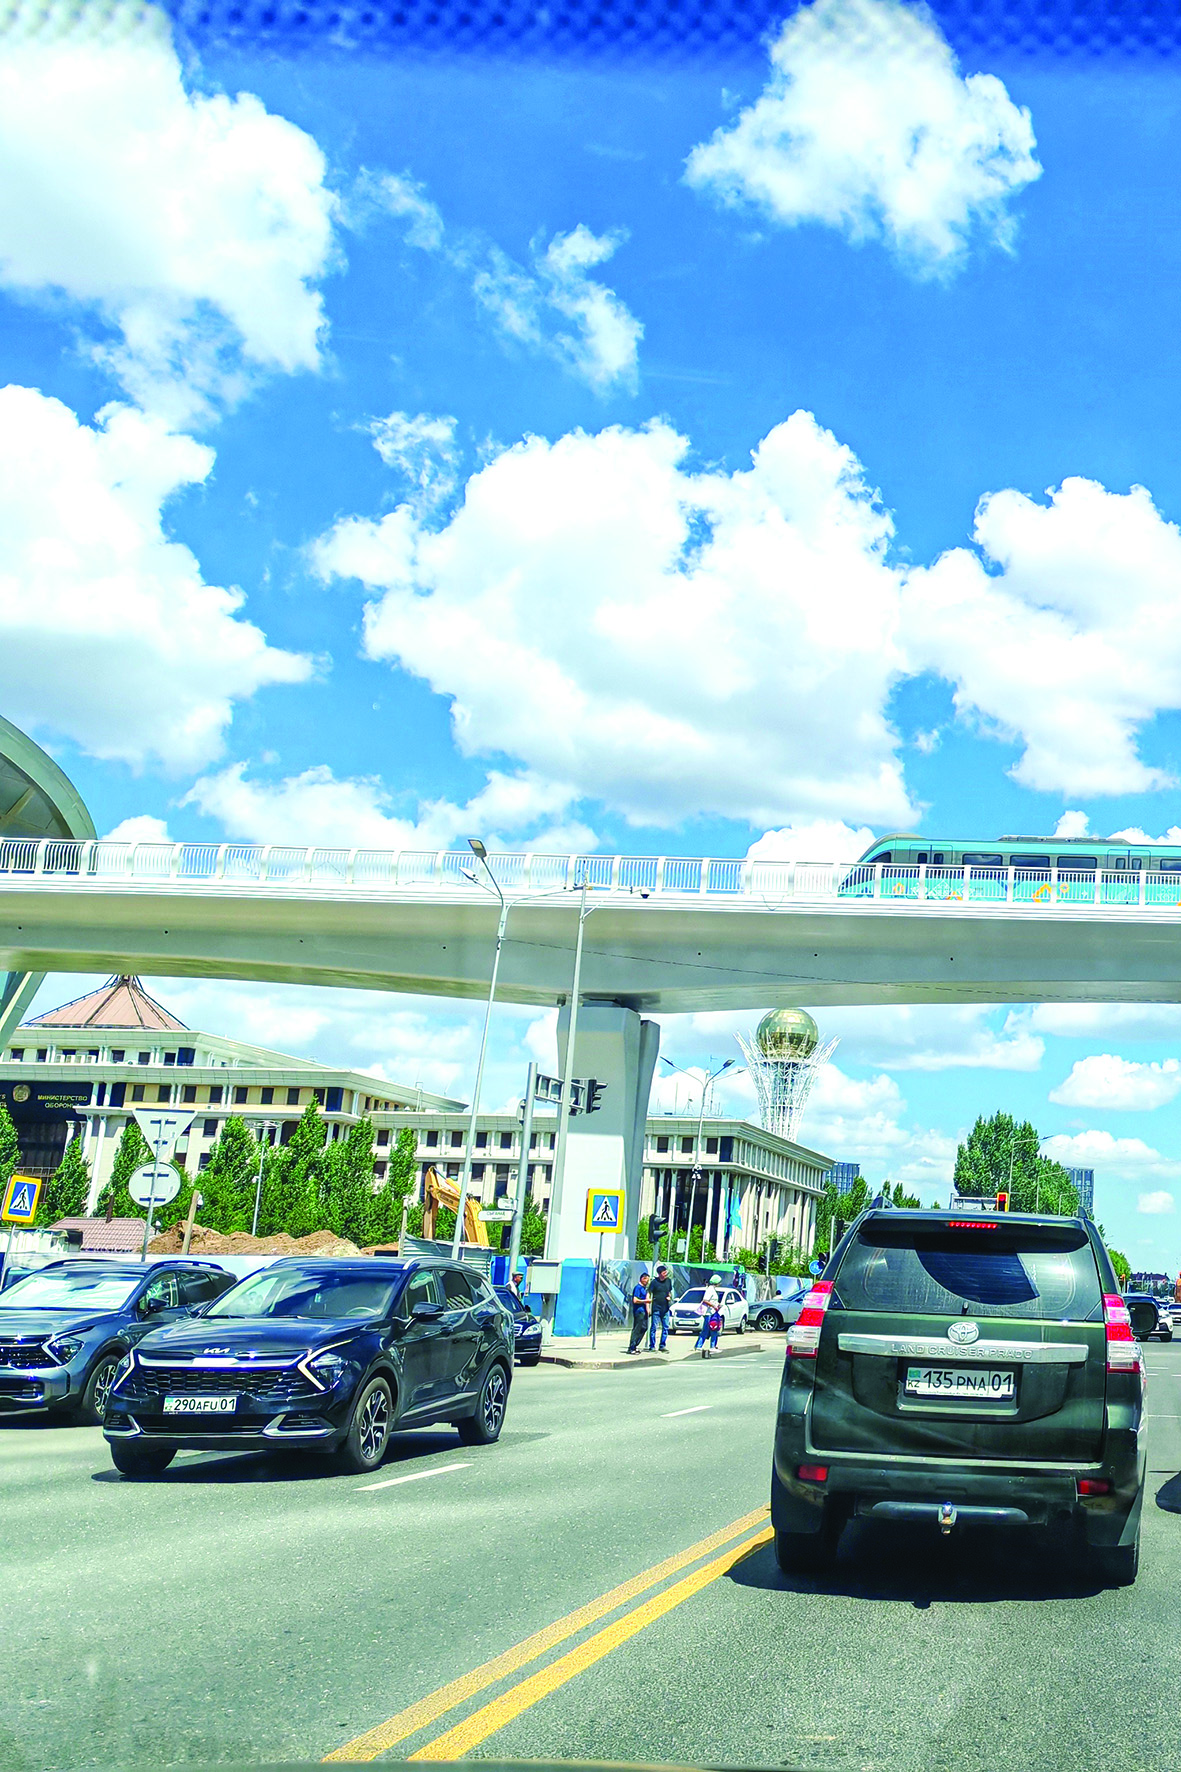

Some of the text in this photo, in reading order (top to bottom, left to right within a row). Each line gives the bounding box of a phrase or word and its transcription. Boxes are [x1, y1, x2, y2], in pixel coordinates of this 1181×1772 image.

[891, 1343, 1034, 1360] LAND CRUISER PRADO
